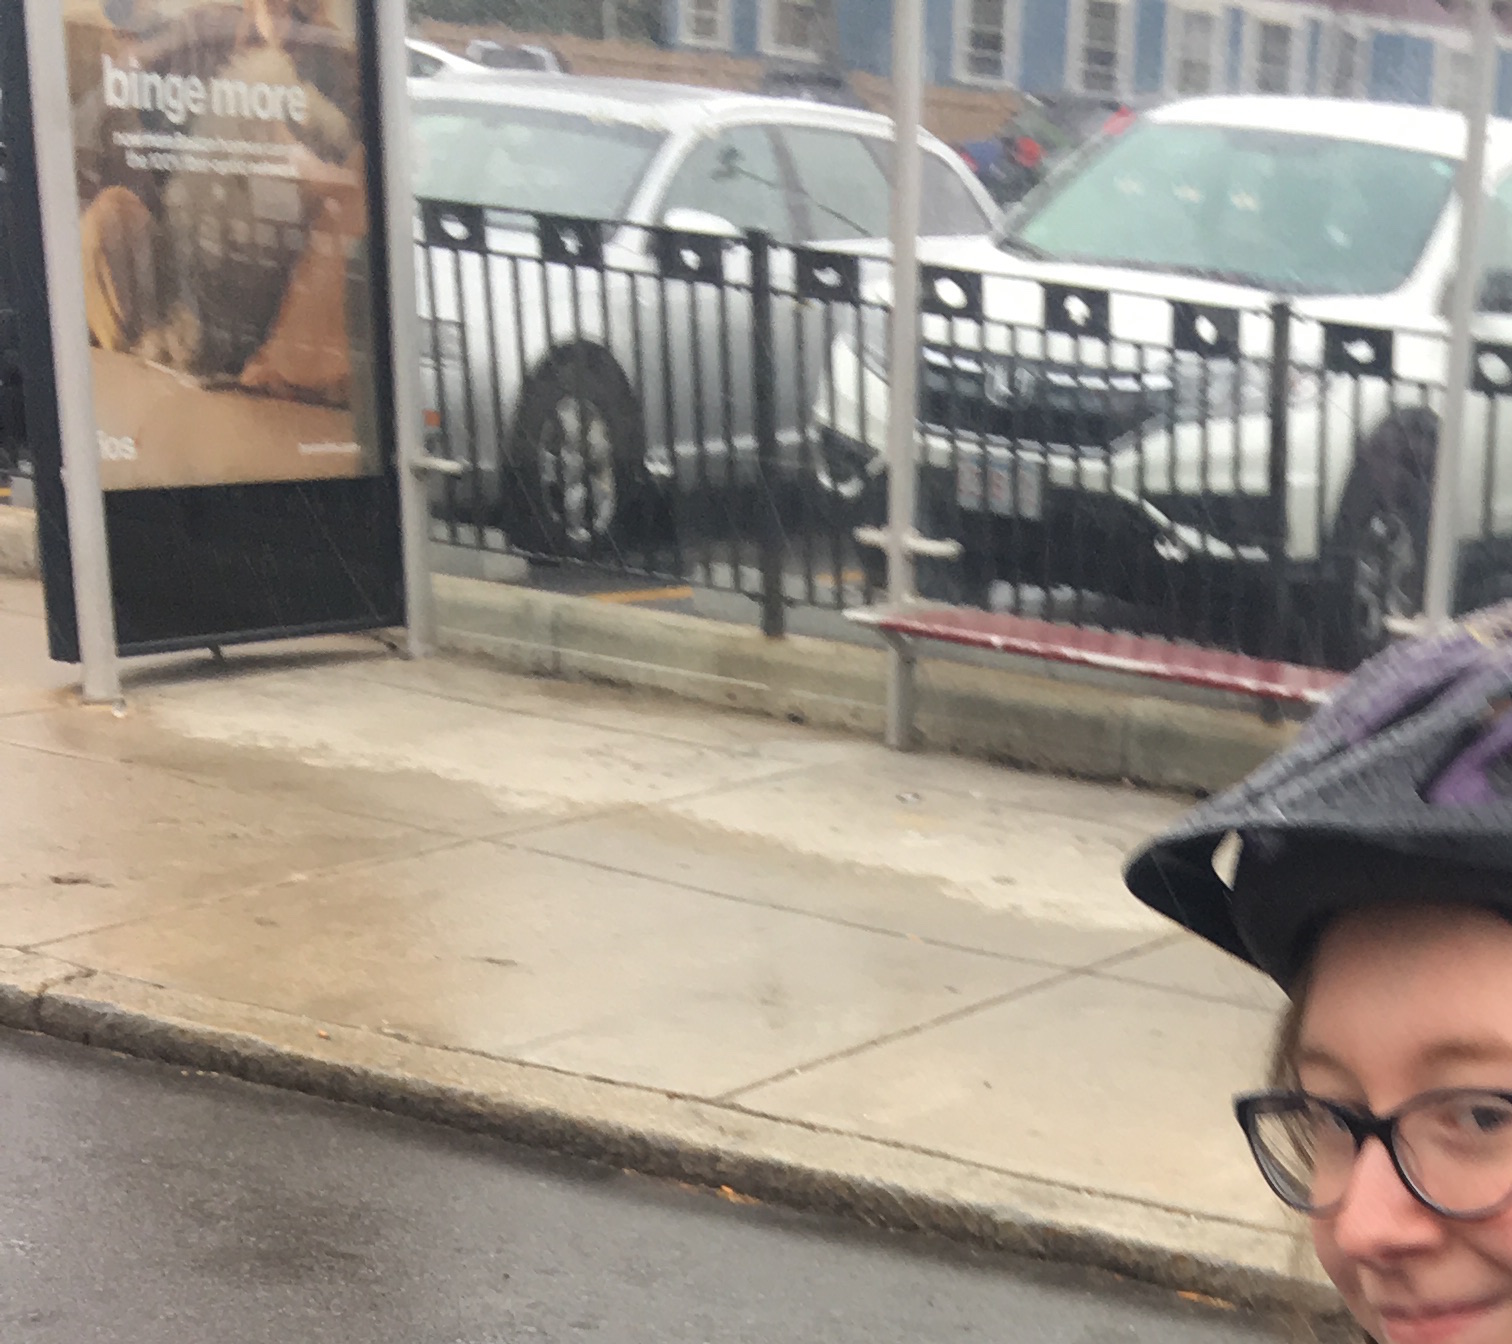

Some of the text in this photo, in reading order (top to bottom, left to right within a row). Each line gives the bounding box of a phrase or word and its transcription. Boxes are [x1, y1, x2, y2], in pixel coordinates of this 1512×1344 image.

[104, 53, 307, 124] binge more
[97, 430, 137, 460] ios
